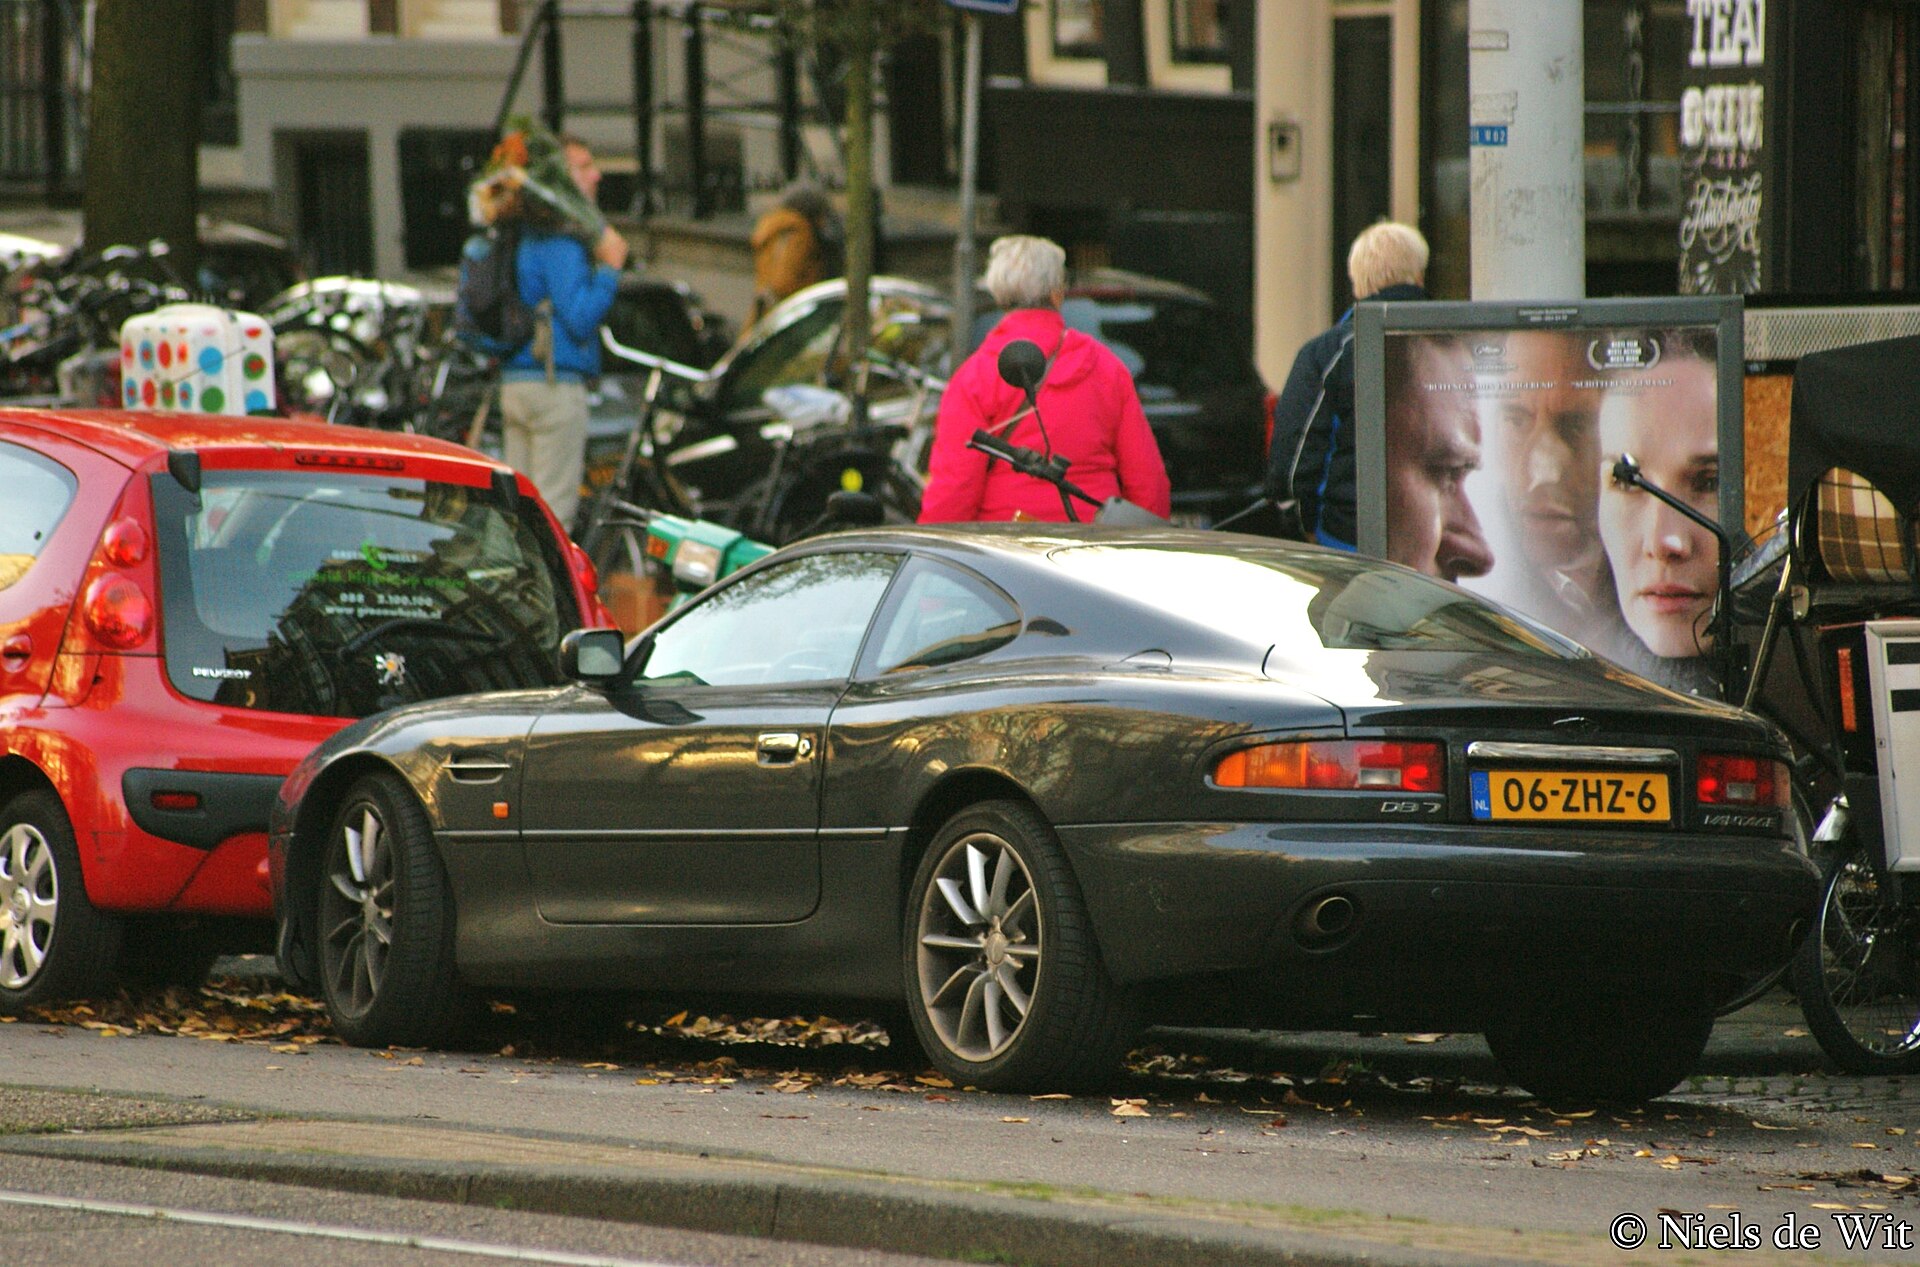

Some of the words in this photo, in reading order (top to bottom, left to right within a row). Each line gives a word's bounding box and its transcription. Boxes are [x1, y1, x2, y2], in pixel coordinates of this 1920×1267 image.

[193, 667, 252, 680] PEUGEOT
[1503, 777, 1657, 814] 06-ZHZ-6
[1475, 800, 1489, 811] NL
